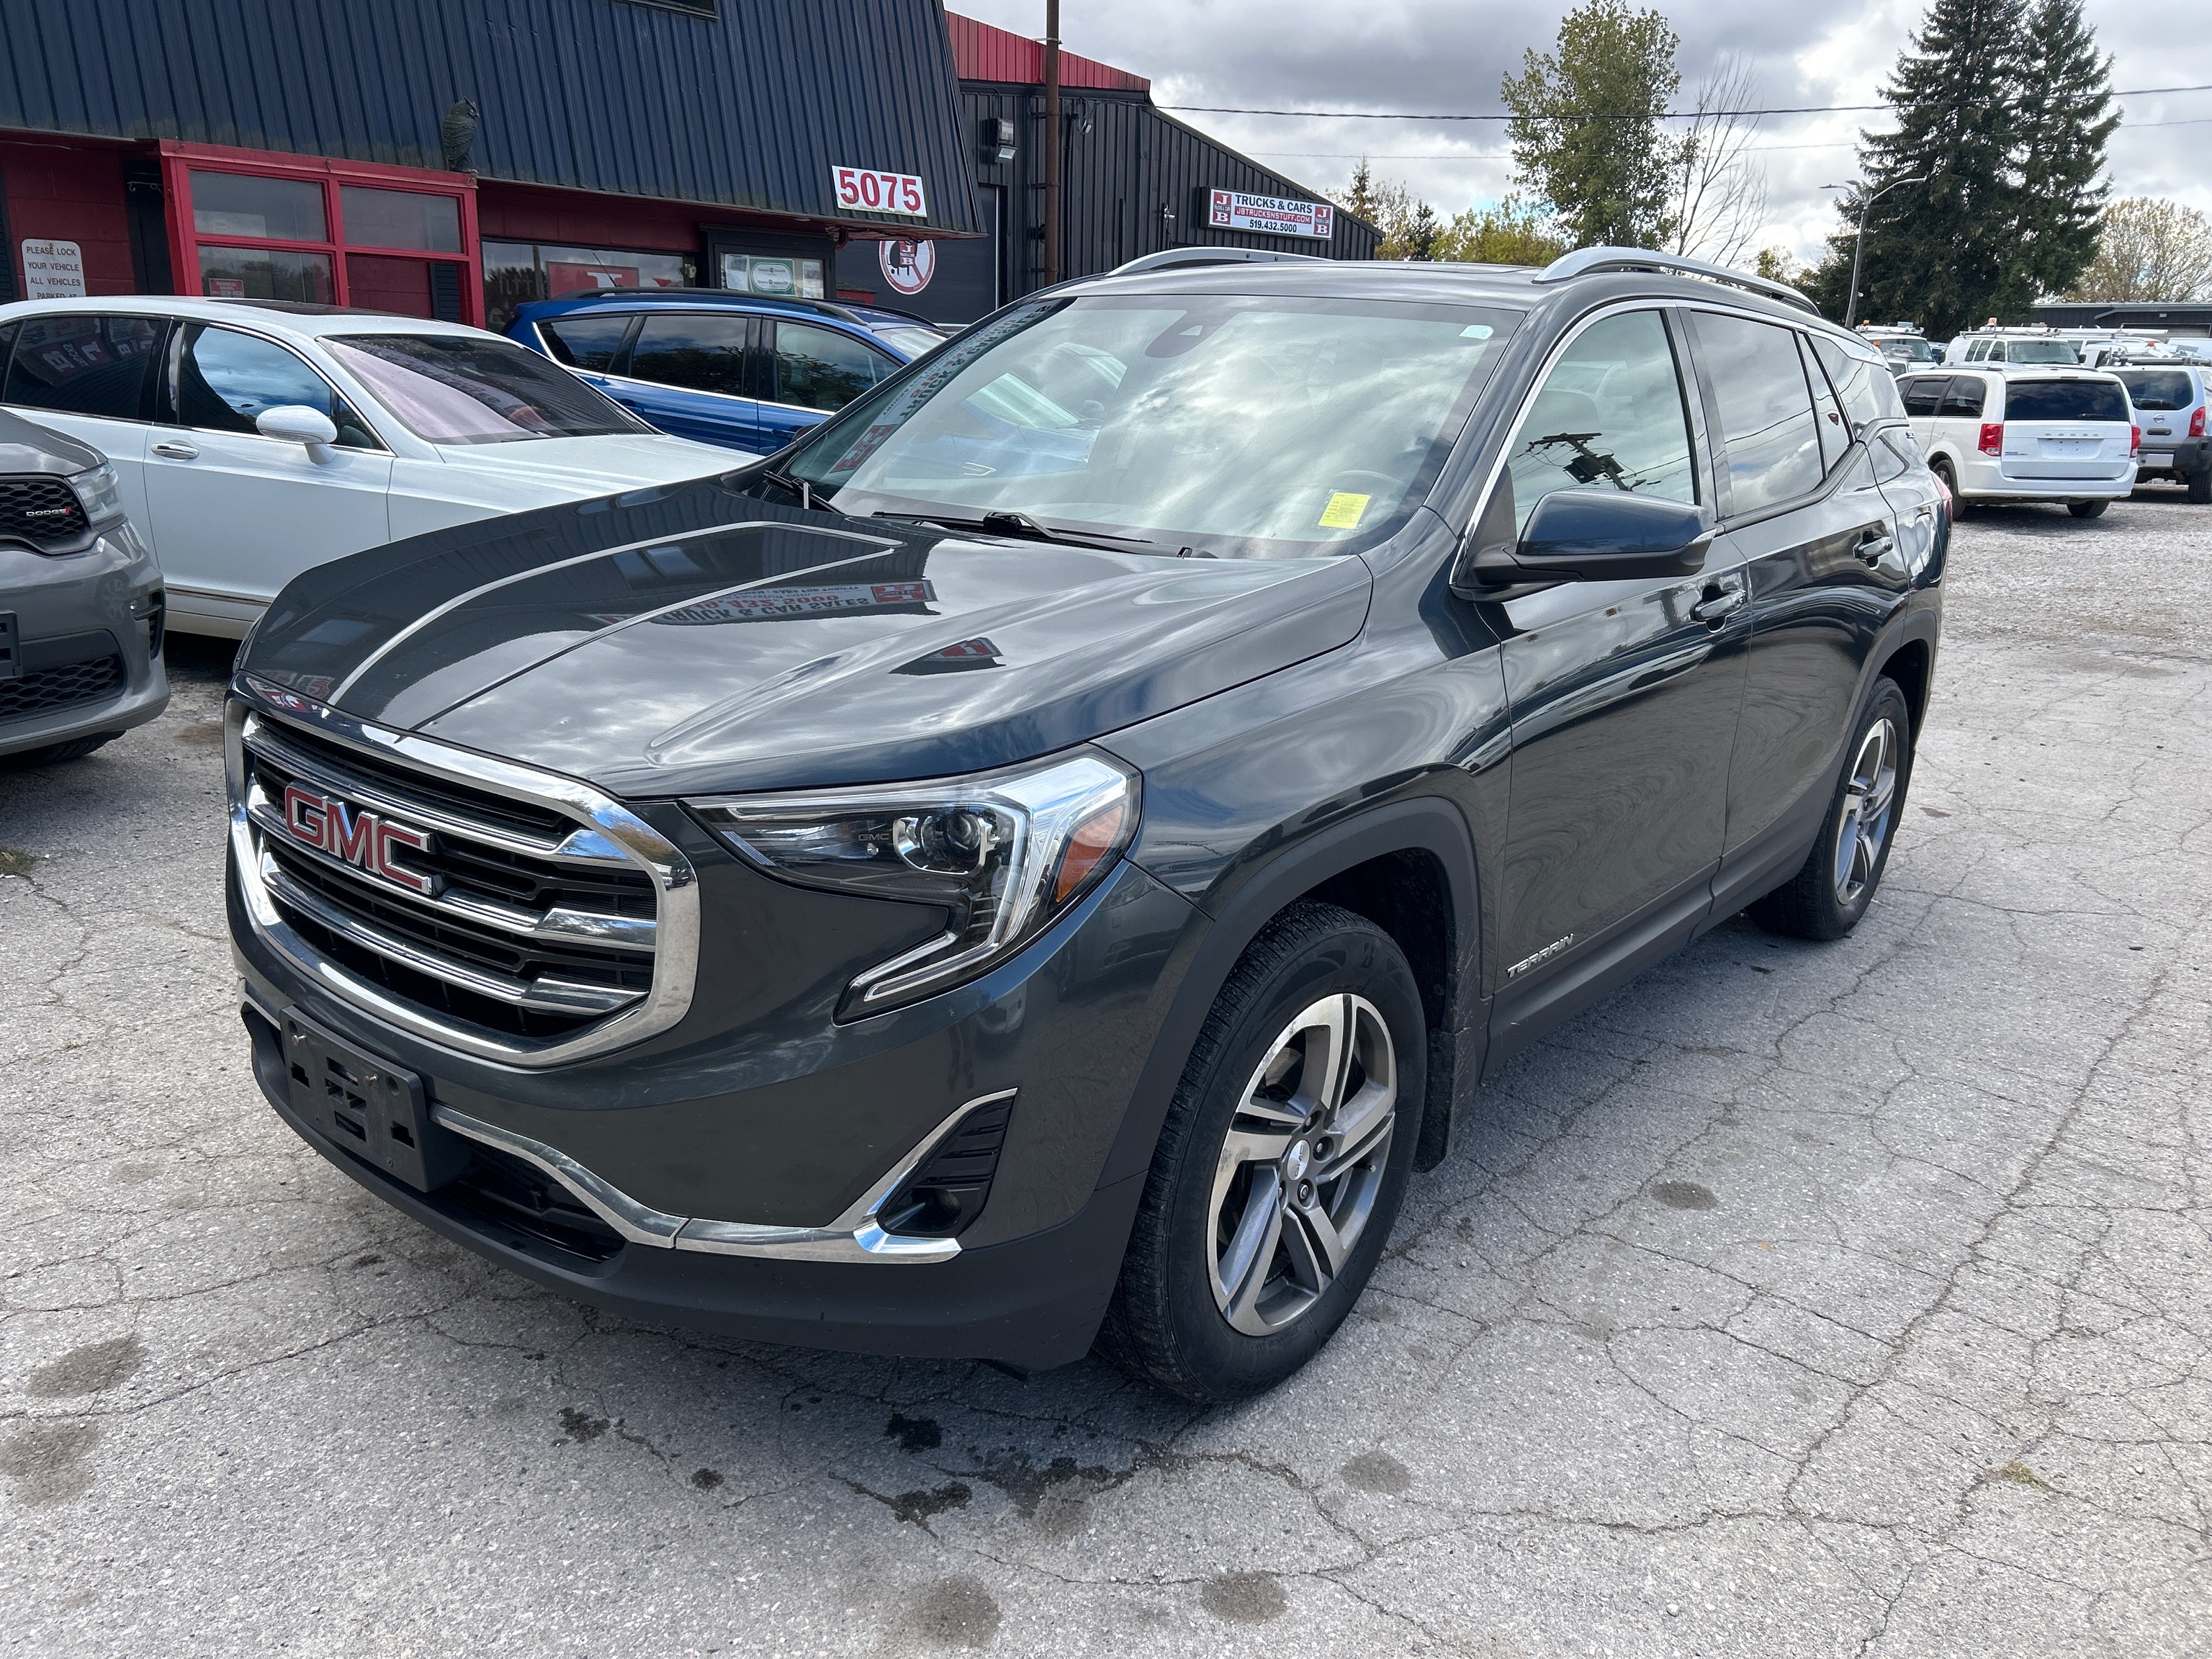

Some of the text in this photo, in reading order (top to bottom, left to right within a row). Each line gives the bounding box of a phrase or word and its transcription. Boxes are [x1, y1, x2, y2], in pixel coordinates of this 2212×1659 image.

[839, 169, 921, 212] 5075
[1216, 194, 1228, 204] J
[1235, 194, 1313, 214] TRUCKS & CARS
[1215, 212, 1228, 222] B
[1236, 208, 1310, 223] JBTRUCKSNSTUFF.COM
[1317, 209, 1328, 218] J
[1249, 219, 1297, 233] 519.432.5000
[1316, 224, 1328, 234] B
[26, 246, 76, 256] PLEASE LOCK
[50, 263, 80, 271] VEHICLE
[47, 277, 81, 287] VEHICLES
[26, 508, 66, 517] DODGE
[284, 781, 432, 895] GMC
[1506, 932, 1574, 979] TERRAIN
[1294, 1144, 1305, 1177] GMC
